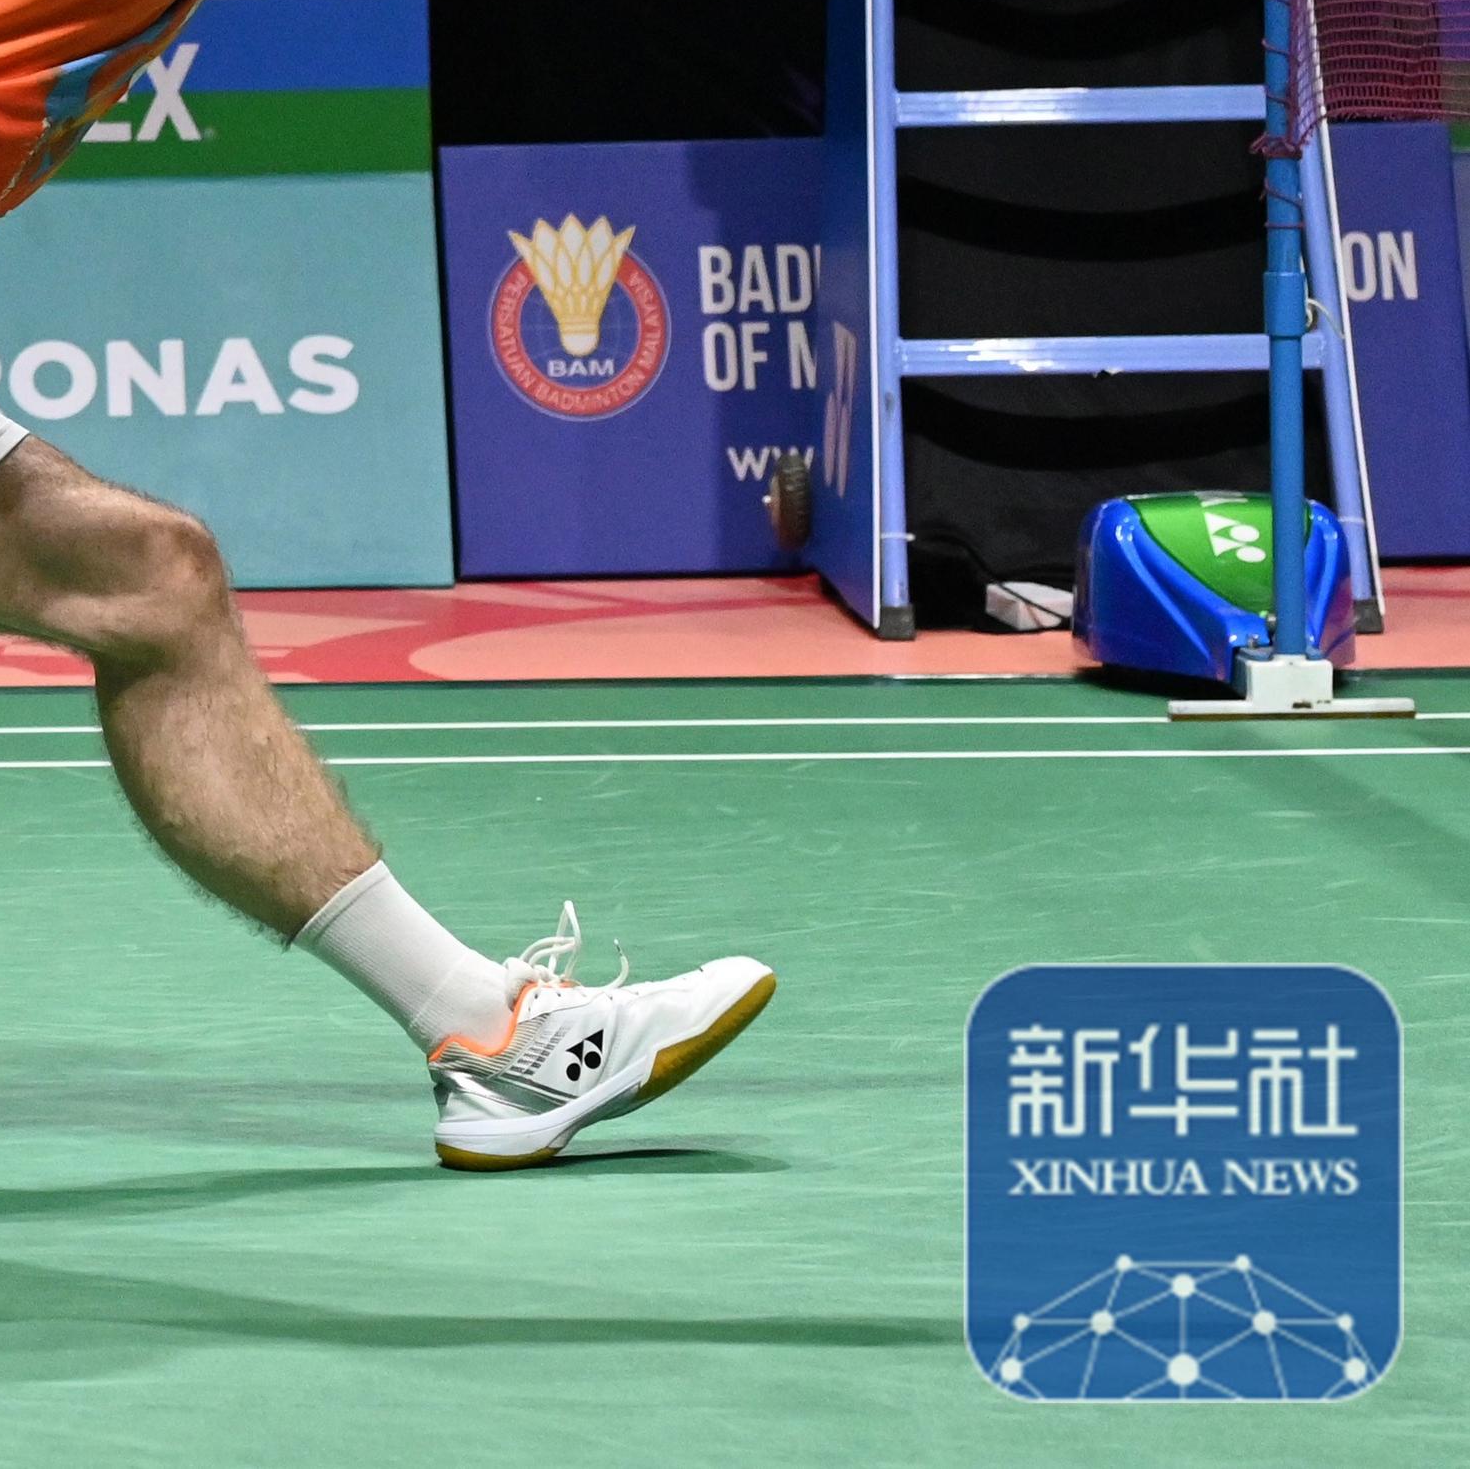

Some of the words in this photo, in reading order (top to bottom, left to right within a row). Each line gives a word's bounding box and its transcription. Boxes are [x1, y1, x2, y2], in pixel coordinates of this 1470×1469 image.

[698, 244, 821, 314] BAD
[547, 359, 615, 378] BAM
[702, 321, 770, 392] OF
